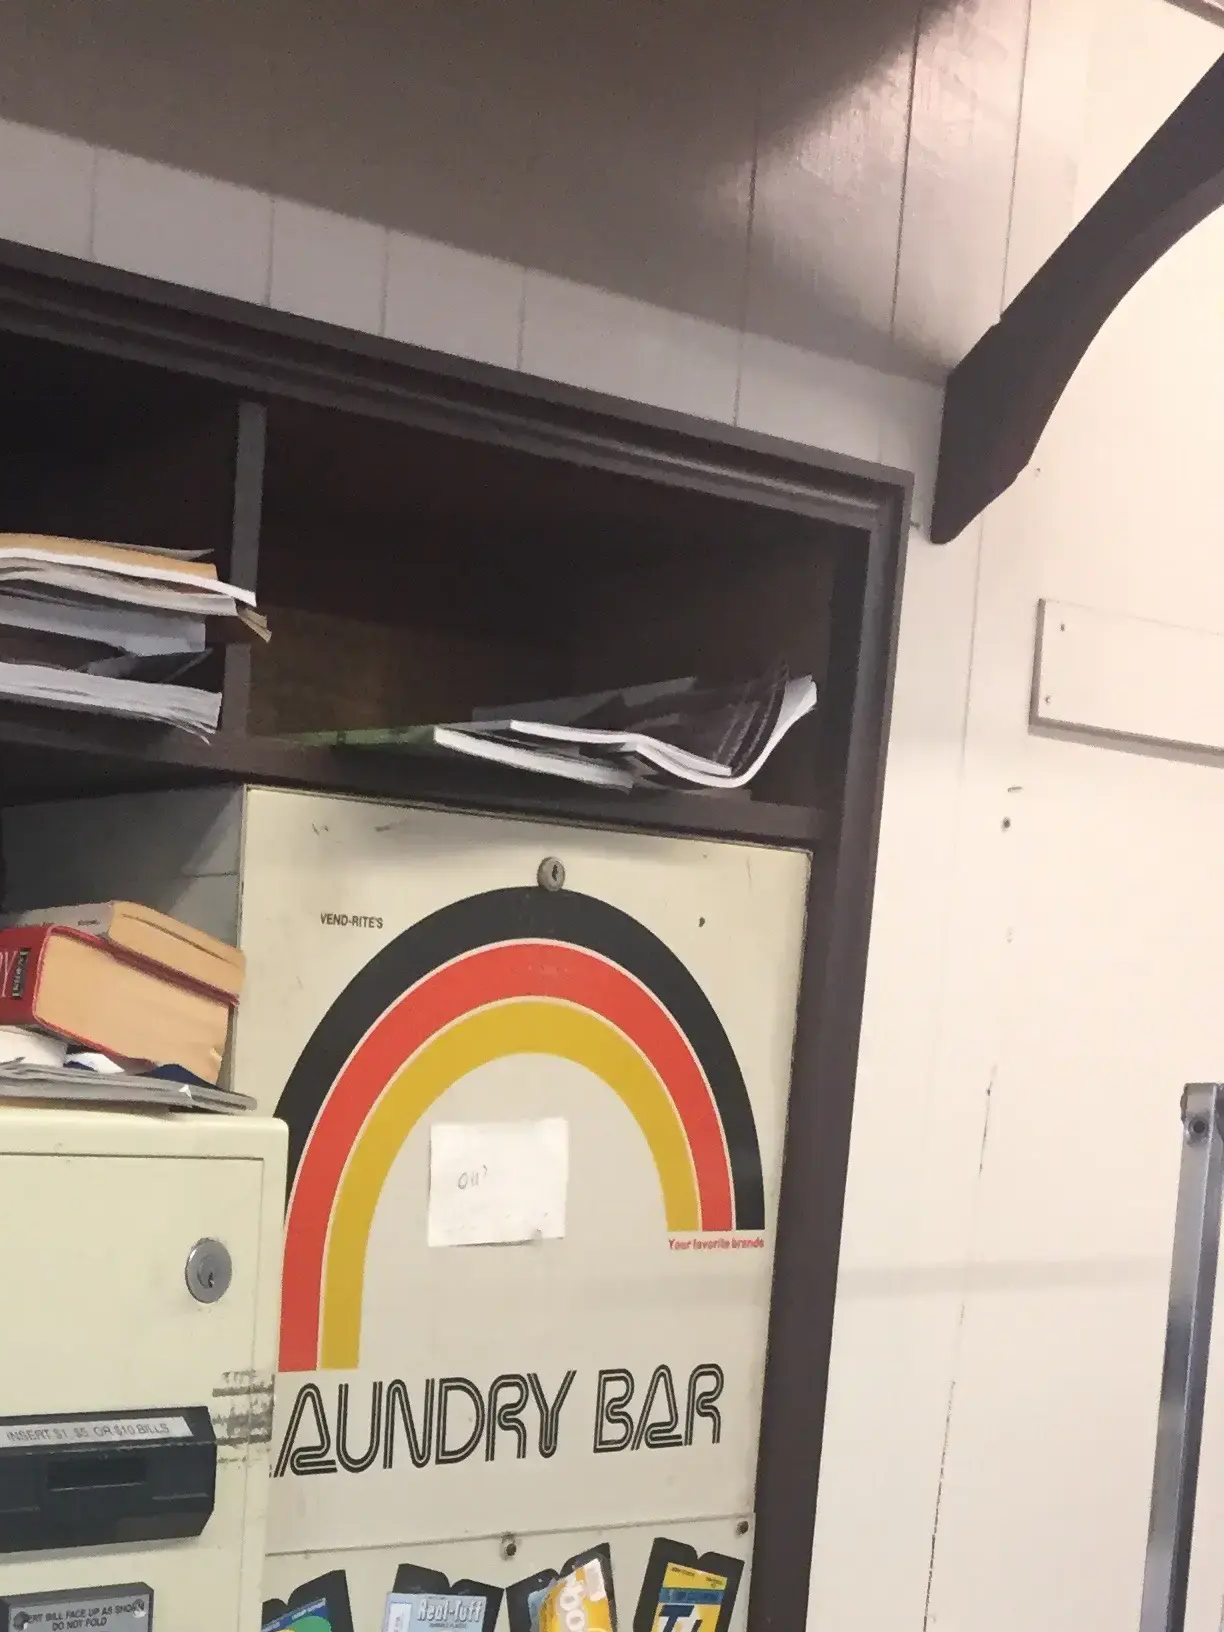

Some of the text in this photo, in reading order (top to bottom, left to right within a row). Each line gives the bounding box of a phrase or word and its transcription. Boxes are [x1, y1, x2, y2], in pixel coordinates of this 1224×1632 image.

[668, 1236, 765, 1250] Your favorite brands
[270, 1363, 725, 1477] AUNDRY BAR
[6, 1428, 51, 1442] INSERT
[93, 1424, 113, 1438] OR
[136, 1422, 170, 1436] BILLS
[45, 1611, 64, 1622] BILL
[65, 1609, 86, 1620] FACE
[88, 1607, 101, 1617] UP
[102, 1605, 113, 1616] AS
[52, 1617, 108, 1631] DO NOT FOLD
